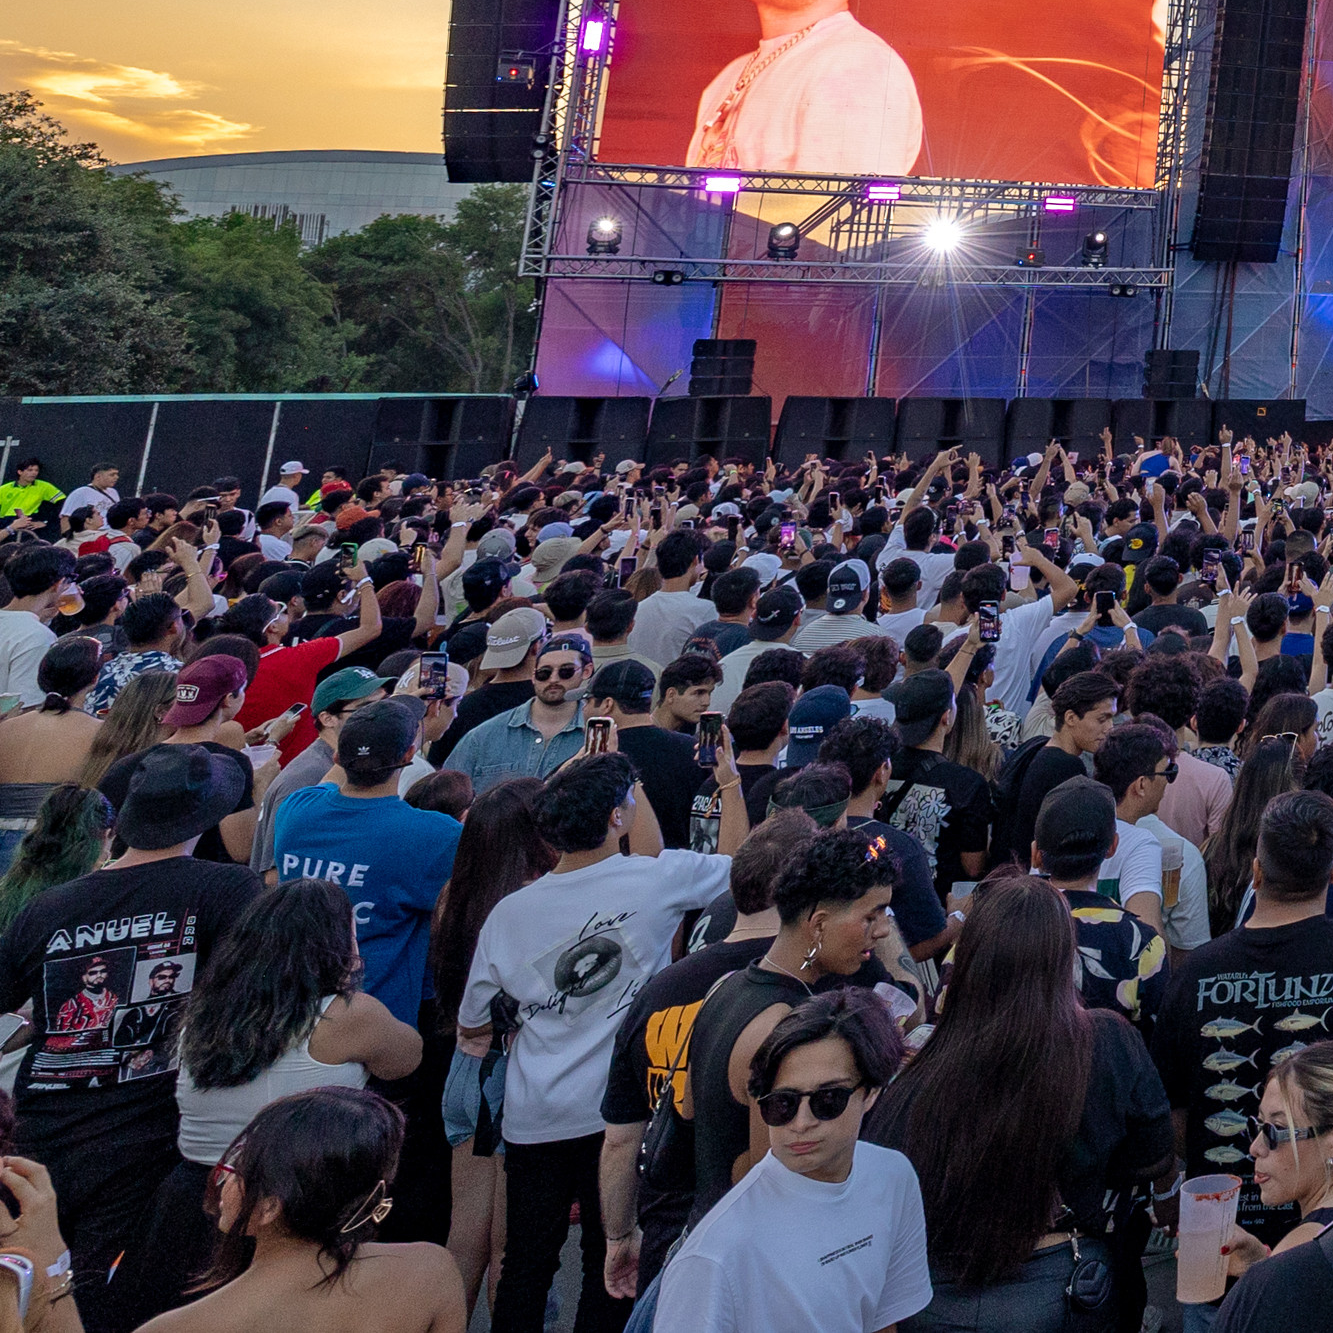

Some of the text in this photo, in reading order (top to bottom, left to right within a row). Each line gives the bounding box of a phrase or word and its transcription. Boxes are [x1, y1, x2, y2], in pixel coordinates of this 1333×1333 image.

[283, 854, 370, 887] PURE
[46, 912, 176, 954] ANUEL
[578, 912, 637, 941] Love
